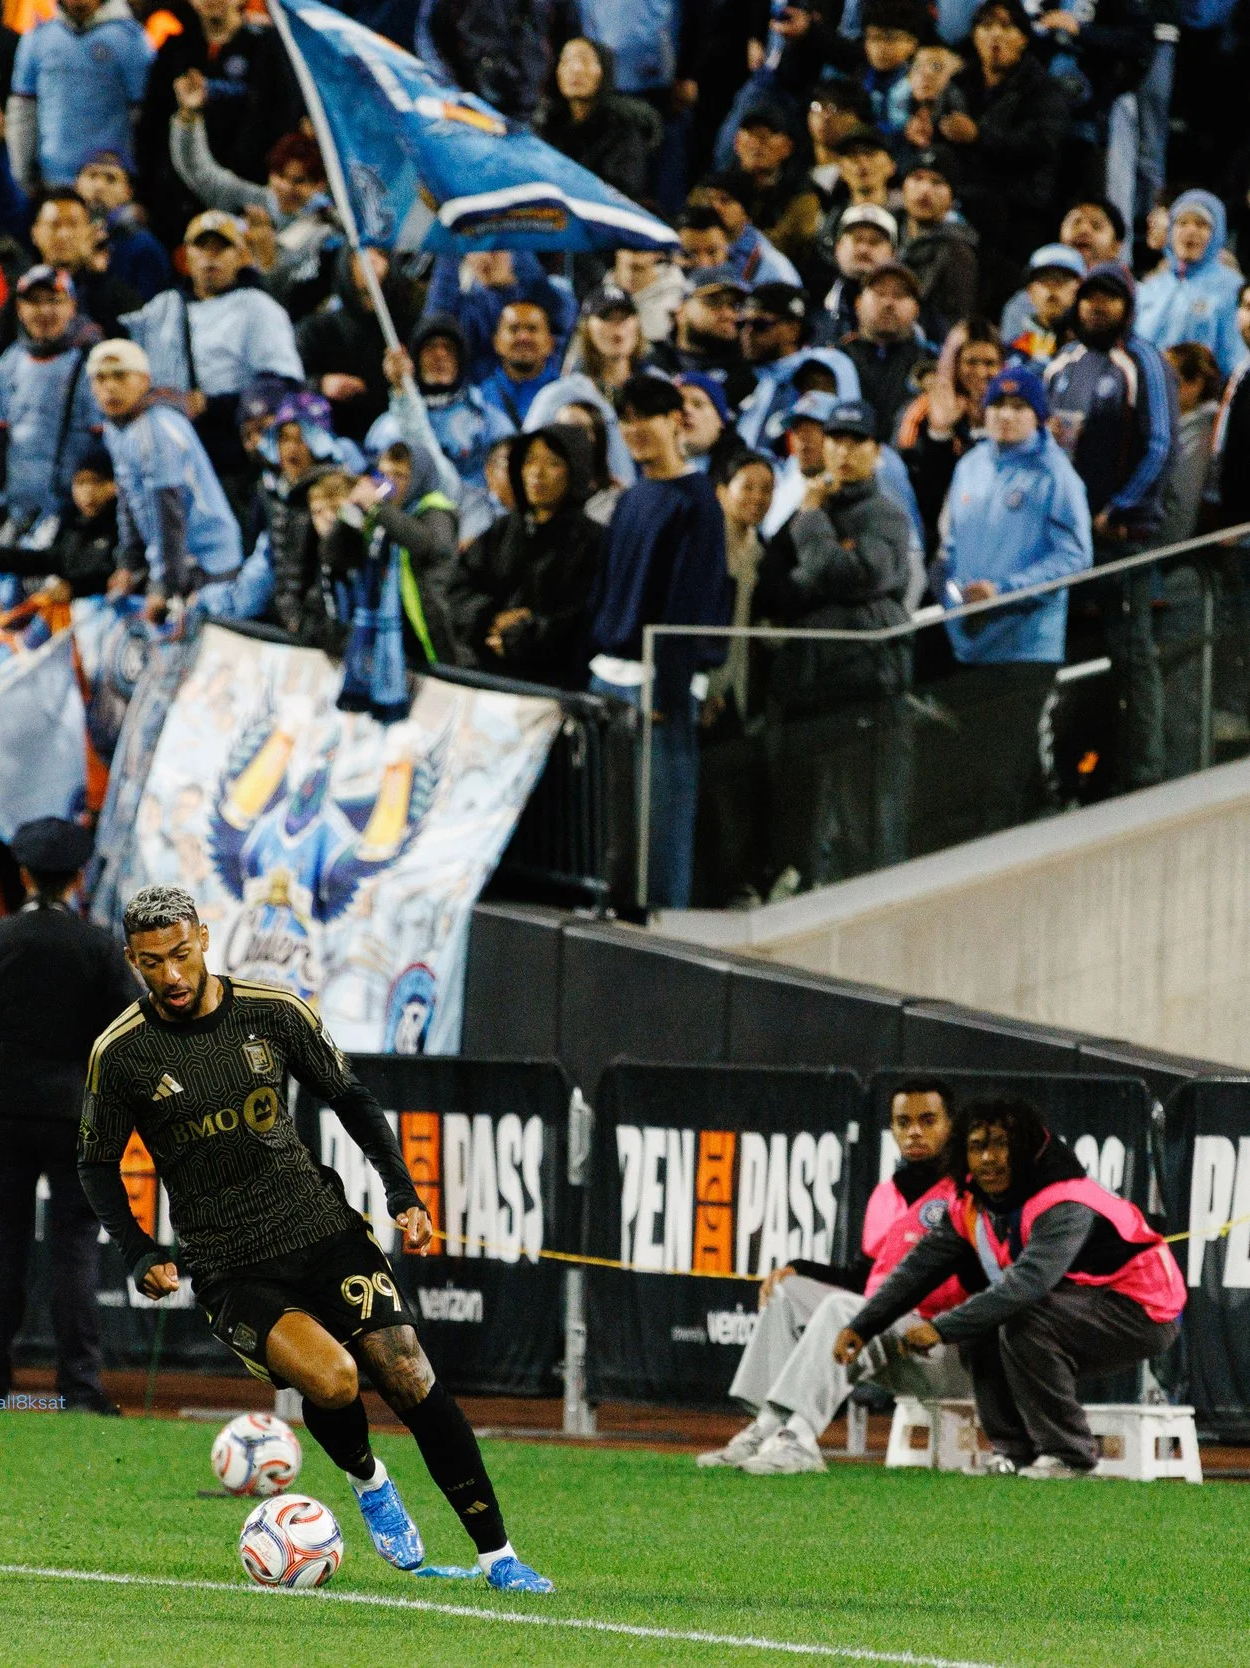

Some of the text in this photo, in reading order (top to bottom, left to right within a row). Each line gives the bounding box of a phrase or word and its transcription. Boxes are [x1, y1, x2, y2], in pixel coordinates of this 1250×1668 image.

[171, 1108, 239, 1143] BMO
[442, 1112, 545, 1265] PASS
[735, 1131, 843, 1281] PASS
[340, 1270, 402, 1321] 99
